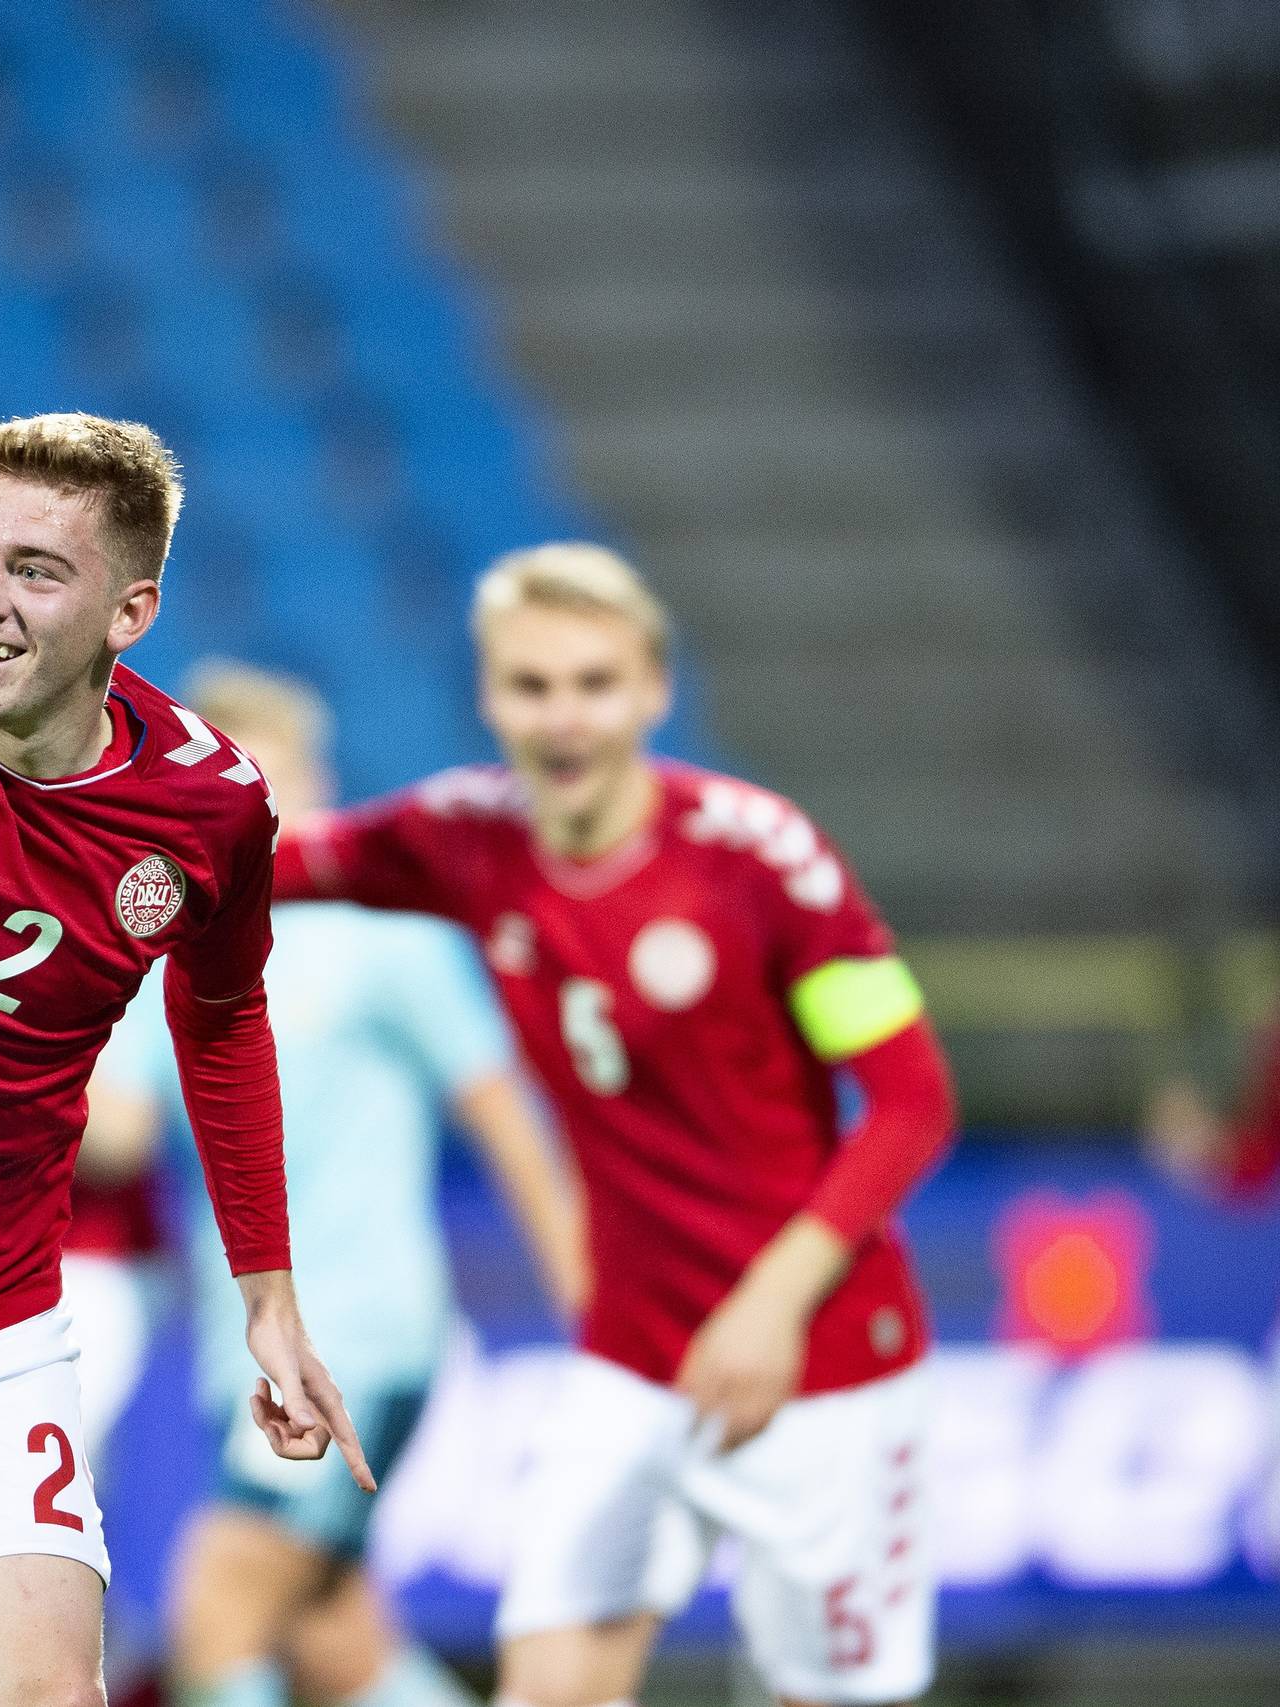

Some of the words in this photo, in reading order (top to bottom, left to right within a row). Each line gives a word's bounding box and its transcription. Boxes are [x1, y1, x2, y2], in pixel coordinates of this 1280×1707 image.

[121, 877, 136, 926] DANSK
[134, 922, 156, 933] 1889
[134, 883, 170, 907] DBU
[27, 1422, 84, 1533] 2
[824, 1574, 876, 1669] 5
